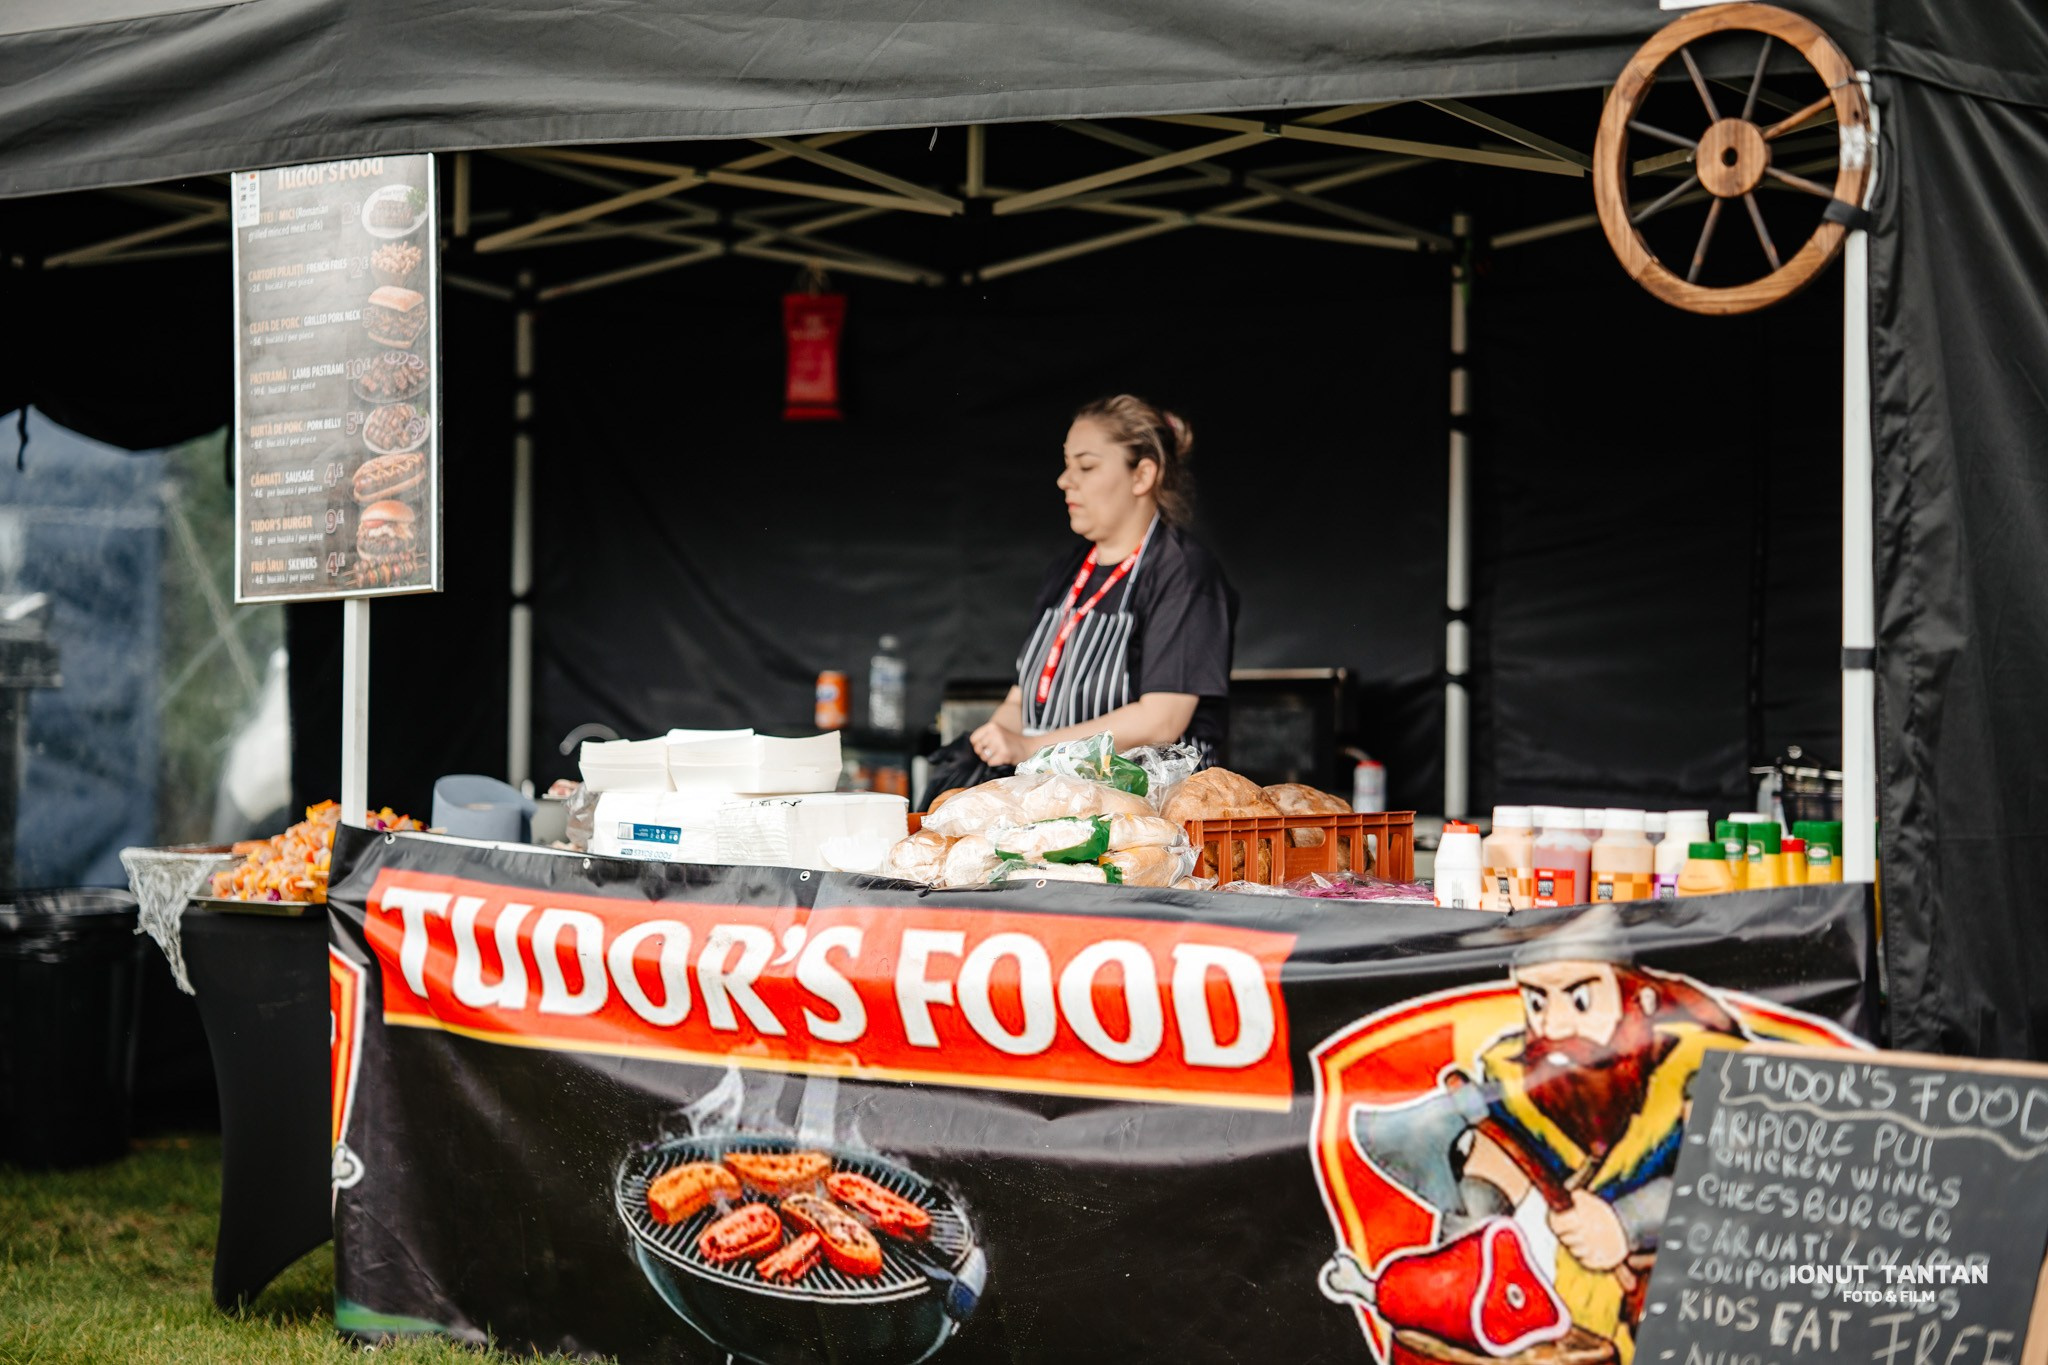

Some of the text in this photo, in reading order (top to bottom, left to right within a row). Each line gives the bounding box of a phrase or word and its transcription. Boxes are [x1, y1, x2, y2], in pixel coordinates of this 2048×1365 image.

[279, 208, 295, 223] MICI
[248, 266, 278, 283] CARTOFI
[306, 260, 330, 274] FRENCH
[330, 258, 347, 270] FRIES
[250, 319, 269, 334] CEAFA
[270, 319, 280, 331] DE
[280, 316, 300, 330] PORC
[303, 314, 327, 327] GRILLED
[328, 311, 345, 324] PORK
[345, 309, 361, 321] NECK
[292, 367, 311, 380] LAMB
[312, 363, 344, 378] PASTRAMI
[273, 421, 282, 434] DE
[282, 419, 303, 433] PORC
[307, 419, 322, 431] PORK
[324, 418, 342, 429] BELLY
[285, 469, 314, 484] SAUSAGE
[251, 515, 313, 533] TUDOR'S BURGER
[287, 557, 318, 570] SKEWERS
[380, 885, 1278, 1071] TUDOR'S FOOD
[1741, 1056, 2048, 1141] TUDOR'S FOOD
[1714, 1148, 1962, 1210] CHICKEN WINGS
[1678, 1287, 1760, 1332] KIDS
[1770, 1301, 1852, 1354] EAT
